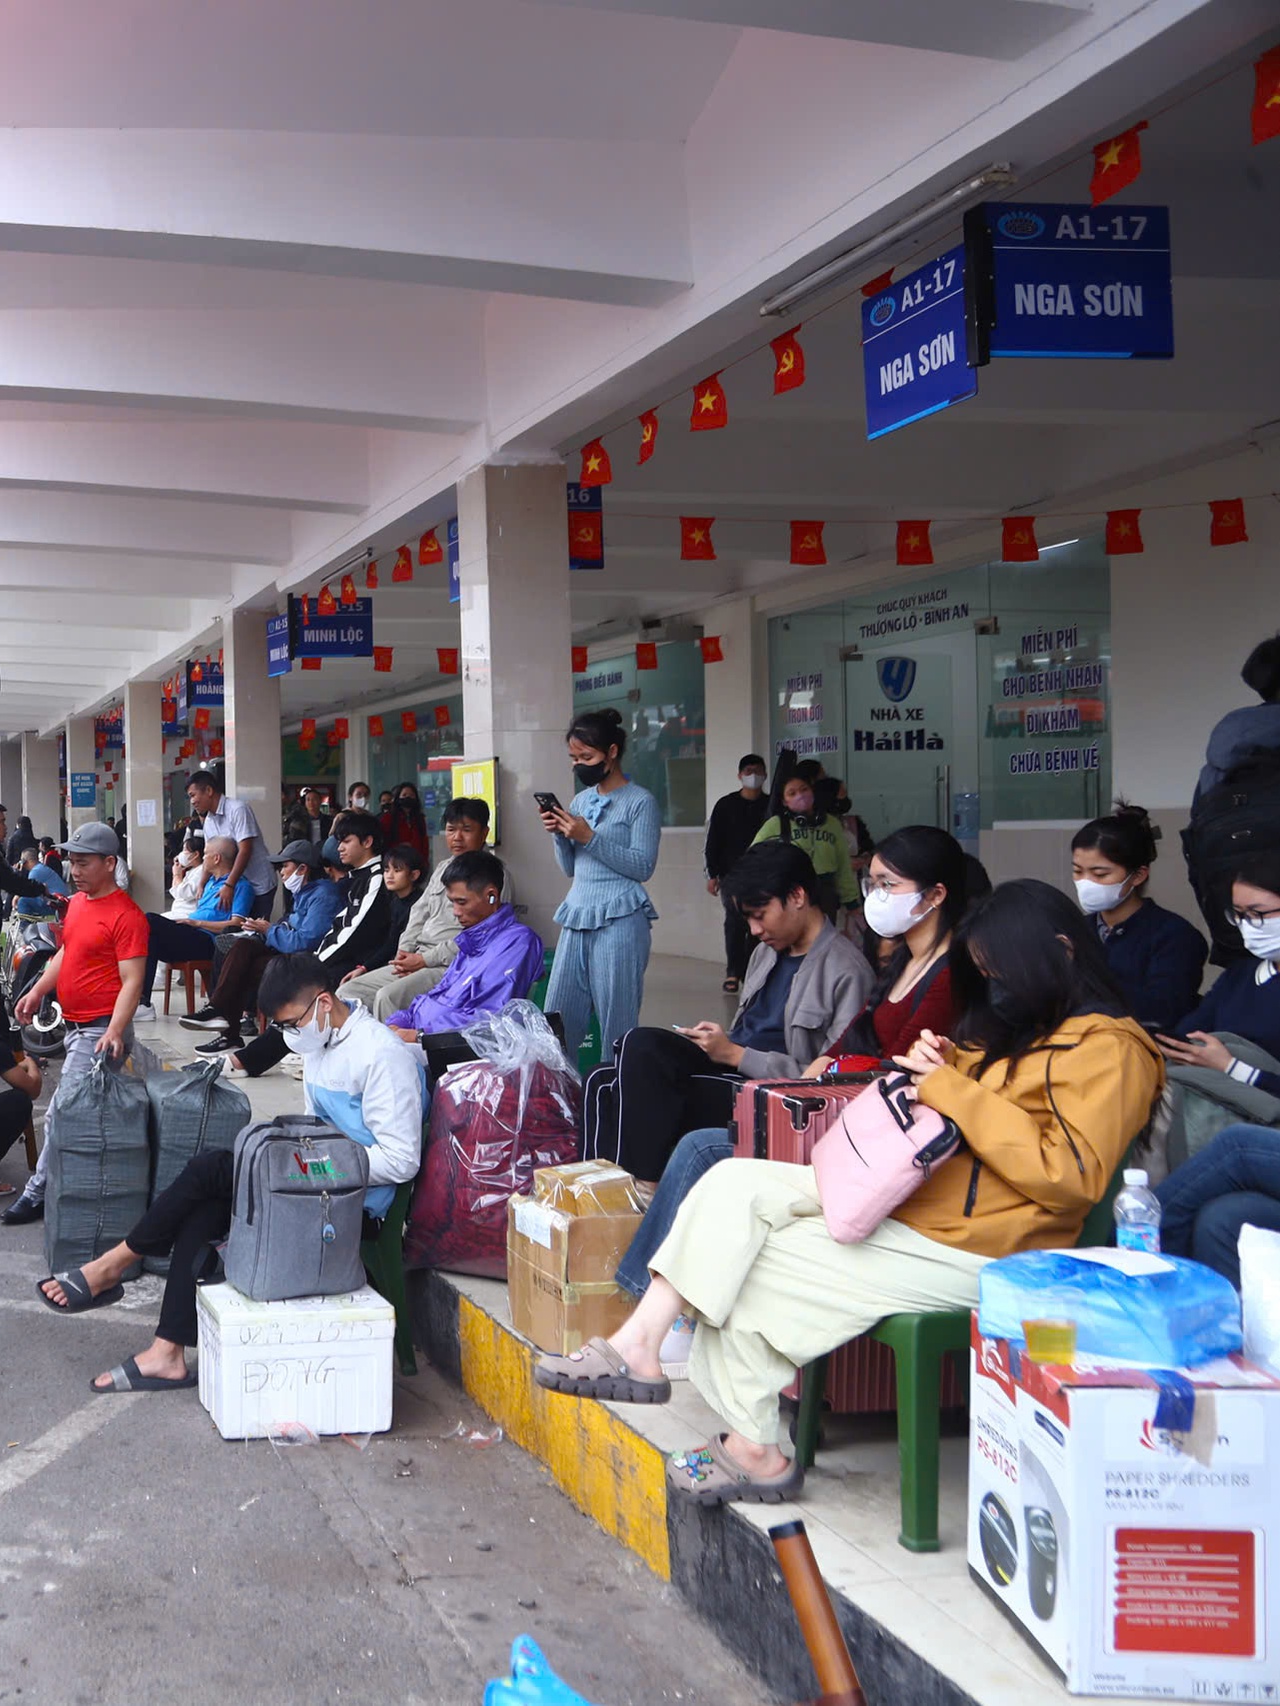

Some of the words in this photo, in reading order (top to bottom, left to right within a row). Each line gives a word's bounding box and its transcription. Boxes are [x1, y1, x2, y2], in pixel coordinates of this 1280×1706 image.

[1055, 214, 1148, 241] A1-17
[901, 259, 956, 312] A1-17
[1014, 283, 1075, 317] NGA
[1083, 281, 1143, 317] SƠN
[879, 352, 915, 396] NGA
[919, 330, 956, 377] SƠN
[952, 602, 970, 620] AN
[303, 629, 337, 642] MINH
[340, 625, 364, 645] LỘC
[1056, 623, 1078, 650] PHÍ
[870, 705, 901, 721] NHÀ
[905, 708, 924, 721] XE
[1104, 1470, 1155, 1487] PAPER
[1157, 1471, 1251, 1488] SHREDDERS
